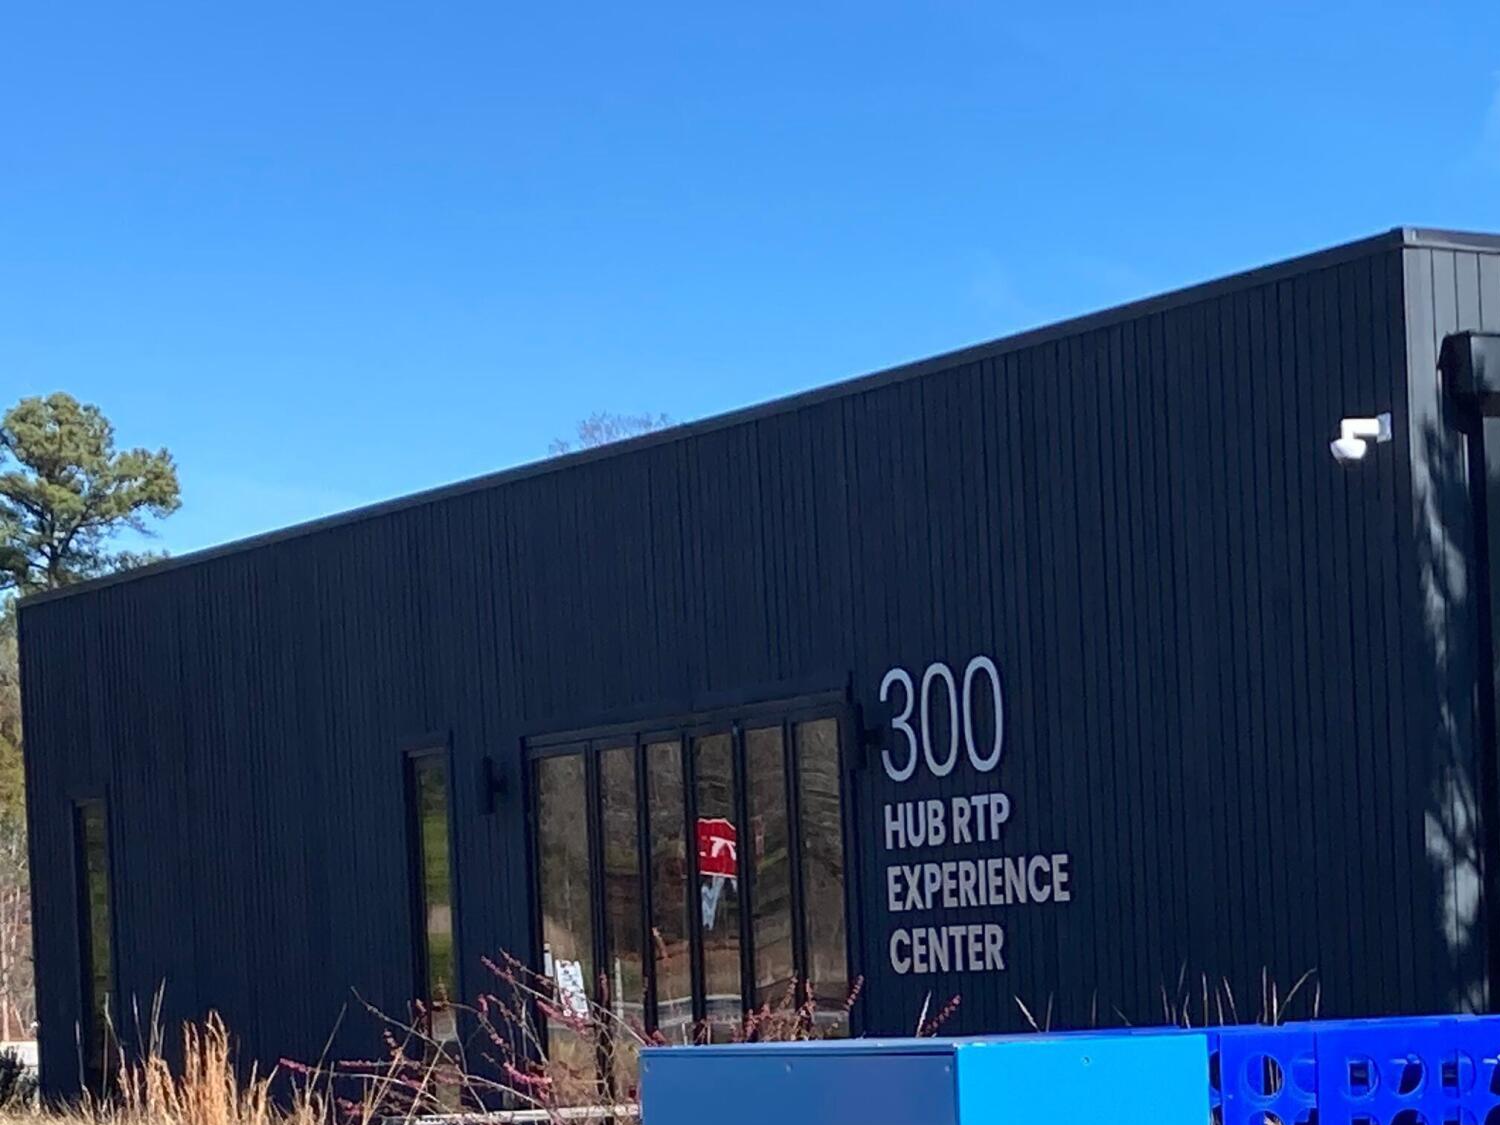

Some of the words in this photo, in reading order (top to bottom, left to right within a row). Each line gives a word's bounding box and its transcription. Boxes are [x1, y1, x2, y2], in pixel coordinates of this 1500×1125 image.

[880, 655, 1003, 782] 300
[884, 799, 947, 850] HUB
[952, 793, 1011, 844] RTP
[887, 854, 1071, 911] EXPERIENCE
[889, 924, 1005, 975] CENTER
